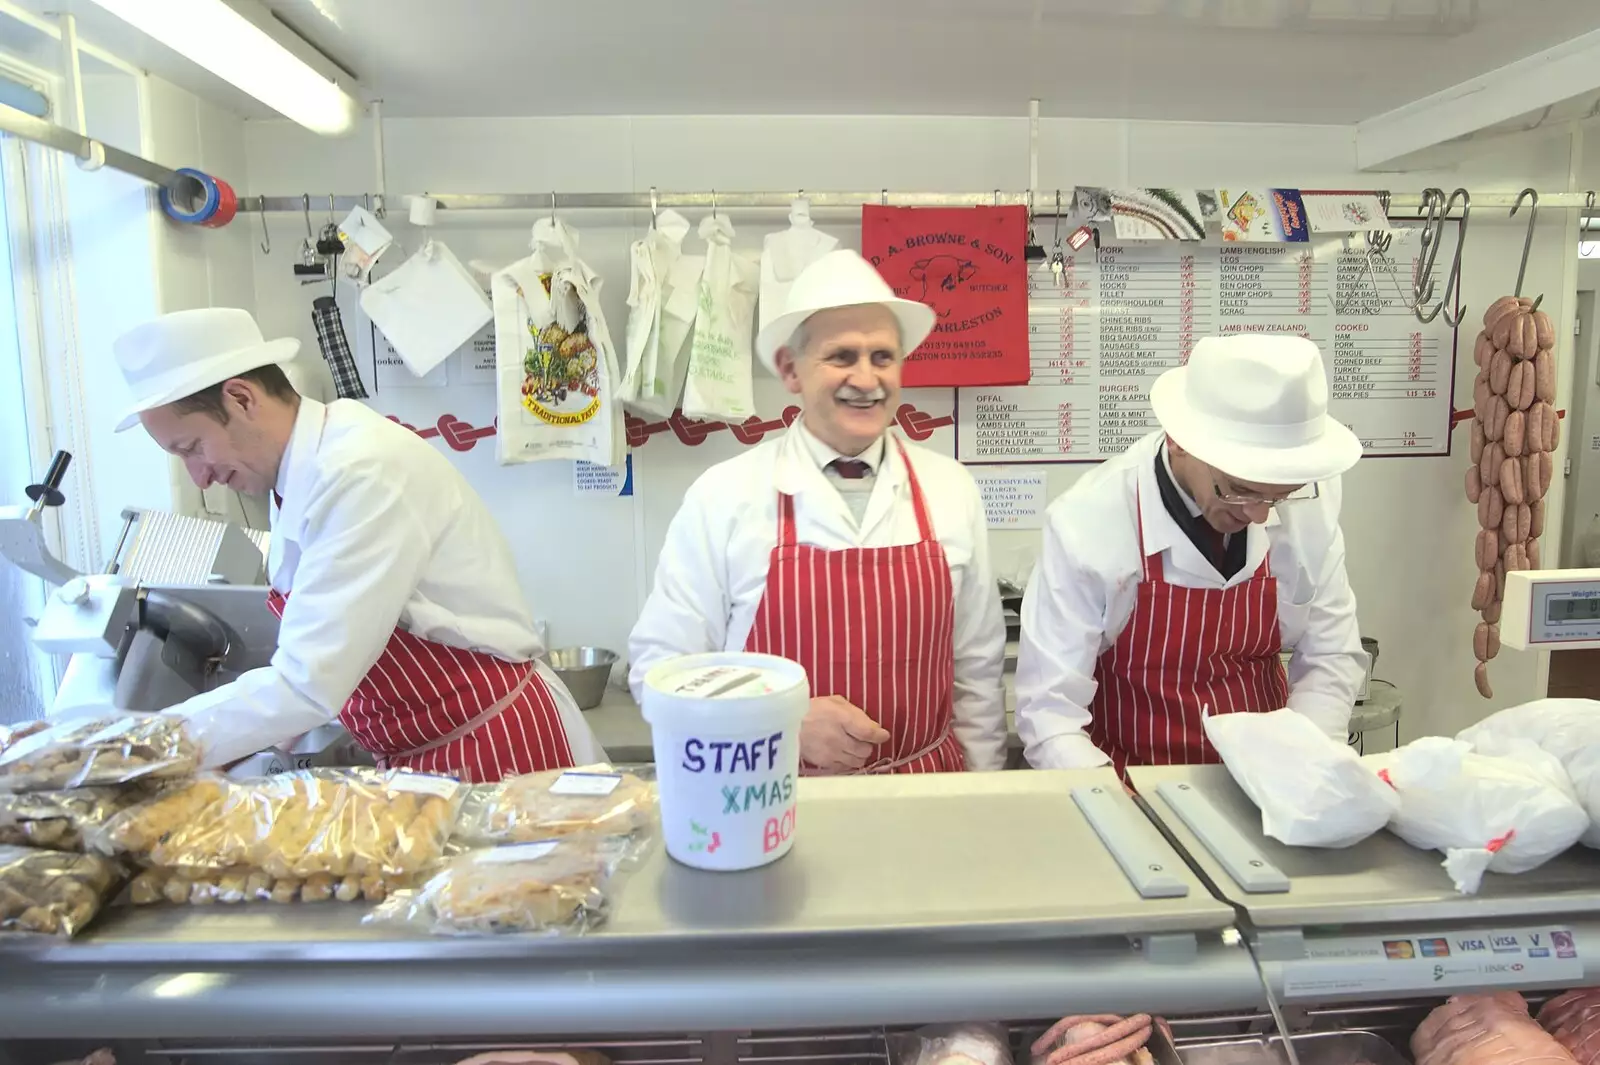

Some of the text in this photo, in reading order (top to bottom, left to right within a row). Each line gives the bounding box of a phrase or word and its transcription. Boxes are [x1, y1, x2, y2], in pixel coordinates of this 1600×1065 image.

[905, 232, 966, 249] BROWNE
[970, 239, 981, 249] &
[984, 243, 1014, 265] SON
[1100, 247, 1124, 255] PORK
[1220, 247, 1286, 255] LAMB (ENGLISH)
[934, 306, 1003, 333] ARLESTON
[1219, 324, 1307, 332] LAMB (NEW ZEALAND)
[1335, 324, 1369, 332] COOKED
[528, 398, 581, 425] TRADITIONAL
[1571, 591, 1597, 599] Weight
[683, 732, 783, 773] STAFF
[721, 774, 793, 814] XMAS
[1457, 939, 1486, 951] VISA
[1493, 936, 1519, 946] VISA
[1529, 933, 1540, 946] V
